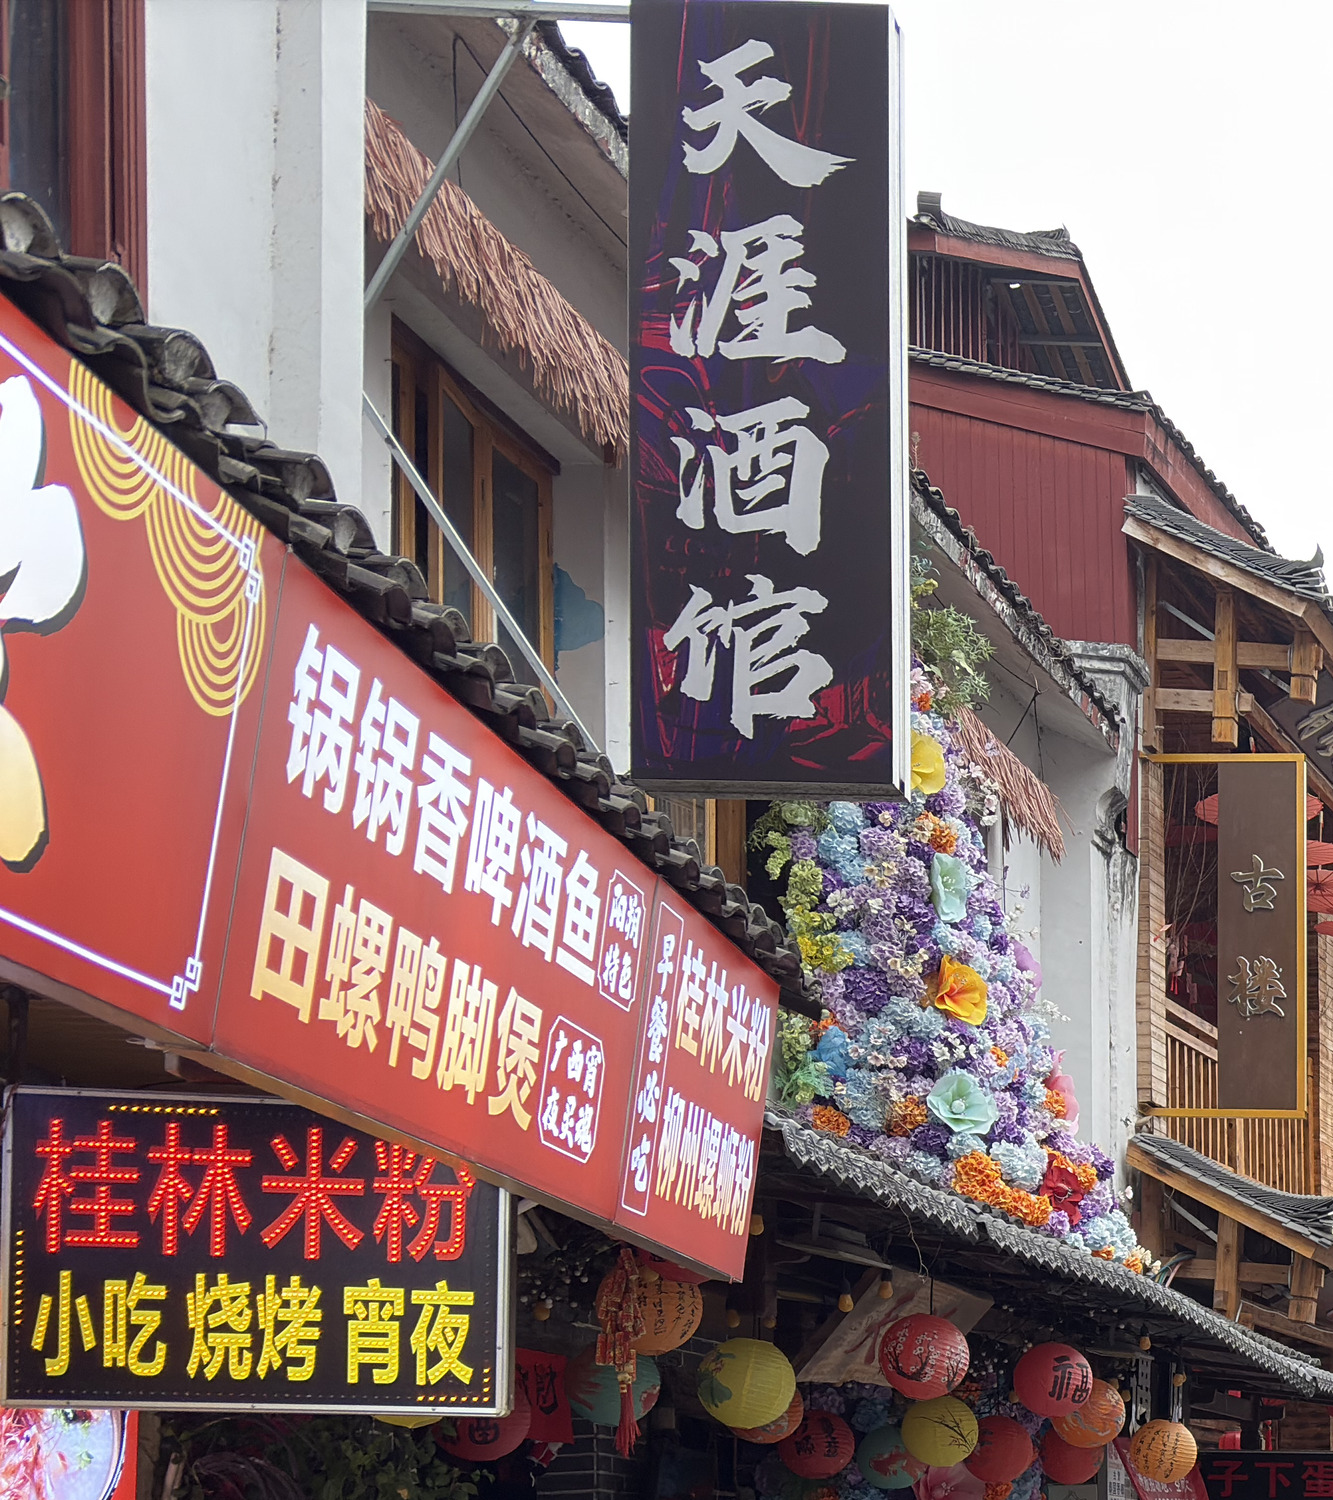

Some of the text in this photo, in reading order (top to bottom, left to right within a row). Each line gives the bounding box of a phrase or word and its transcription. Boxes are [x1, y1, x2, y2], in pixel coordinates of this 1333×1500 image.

[662, 39, 856, 739] 天涯酒馆
[286, 623, 601, 986] 锅锅香啤酒鱼
[250, 847, 543, 1129] 田螺鸭脚煲
[601, 945, 633, 1002] 特色
[608, 882, 645, 950] 阳朔
[631, 933, 675, 1193] 早餐必吃
[674, 938, 770, 1102] 桂林米粉
[32, 1117, 477, 1263] 桂林米粉
[654, 1086, 755, 1237] 柳州螺蛳粉
[31, 1269, 475, 1386] 小吃 烧烤 宵夜
